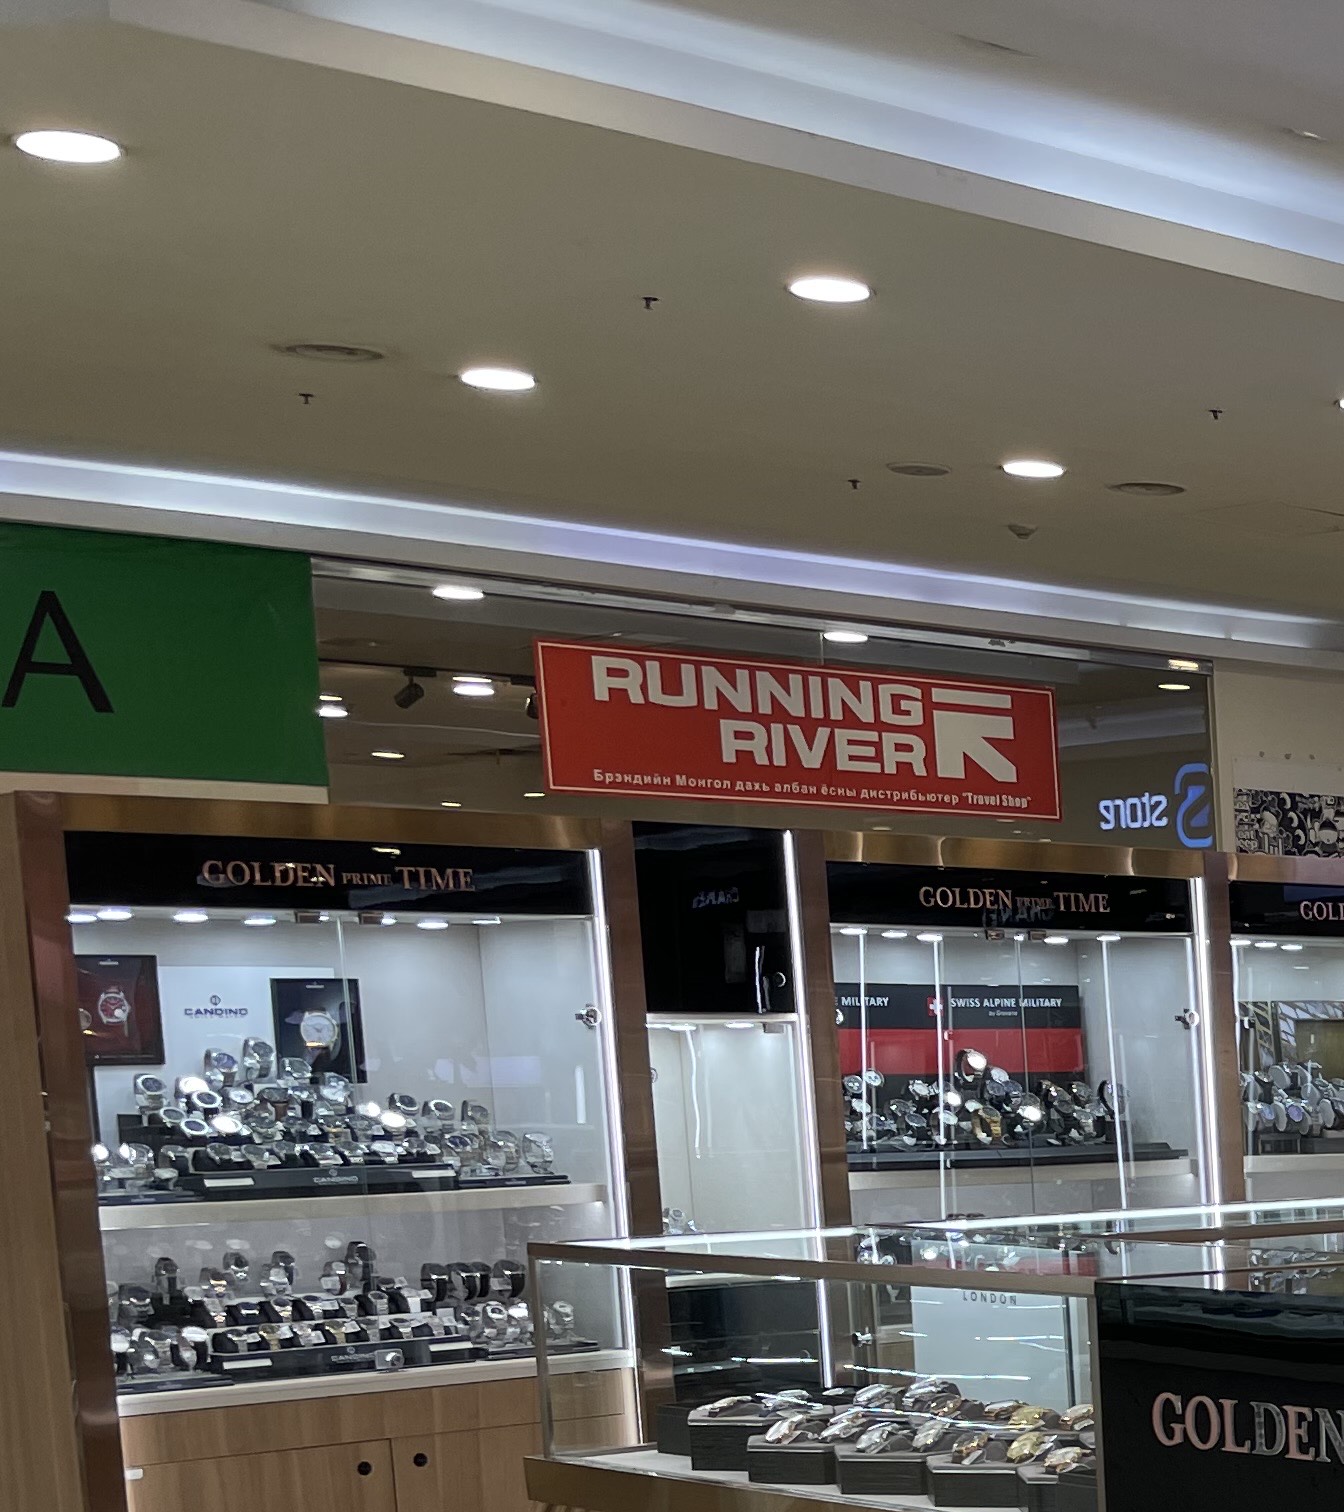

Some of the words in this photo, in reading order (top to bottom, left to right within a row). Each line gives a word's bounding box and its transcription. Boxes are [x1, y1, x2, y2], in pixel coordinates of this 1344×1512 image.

[591, 655, 924, 726] RUNNING
[719, 719, 927, 777] RIVER
[593, 769, 671, 786] Брэндийн
[675, 775, 731, 790] Монгол
[735, 781, 770, 792] дахь
[774, 782, 816, 794] албан
[821, 784, 856, 798] ёсны
[860, 789, 959, 805] дистрибьютер
[202, 860, 336, 887] GOLDEN
[341, 872, 392, 886] PRIME
[395, 866, 475, 892] TIME
[919, 886, 1012, 909] GOLDEN
[1053, 891, 1110, 913] TIME
[184, 1007, 248, 1016] CANDINO
[841, 996, 889, 1007] MILTARY
[950, 998, 980, 1008] SWISS
[983, 998, 1016, 1008] ALPINE
[1019, 998, 1062, 1008] MILITARY
[962, 1291, 1017, 1305] LONDON
